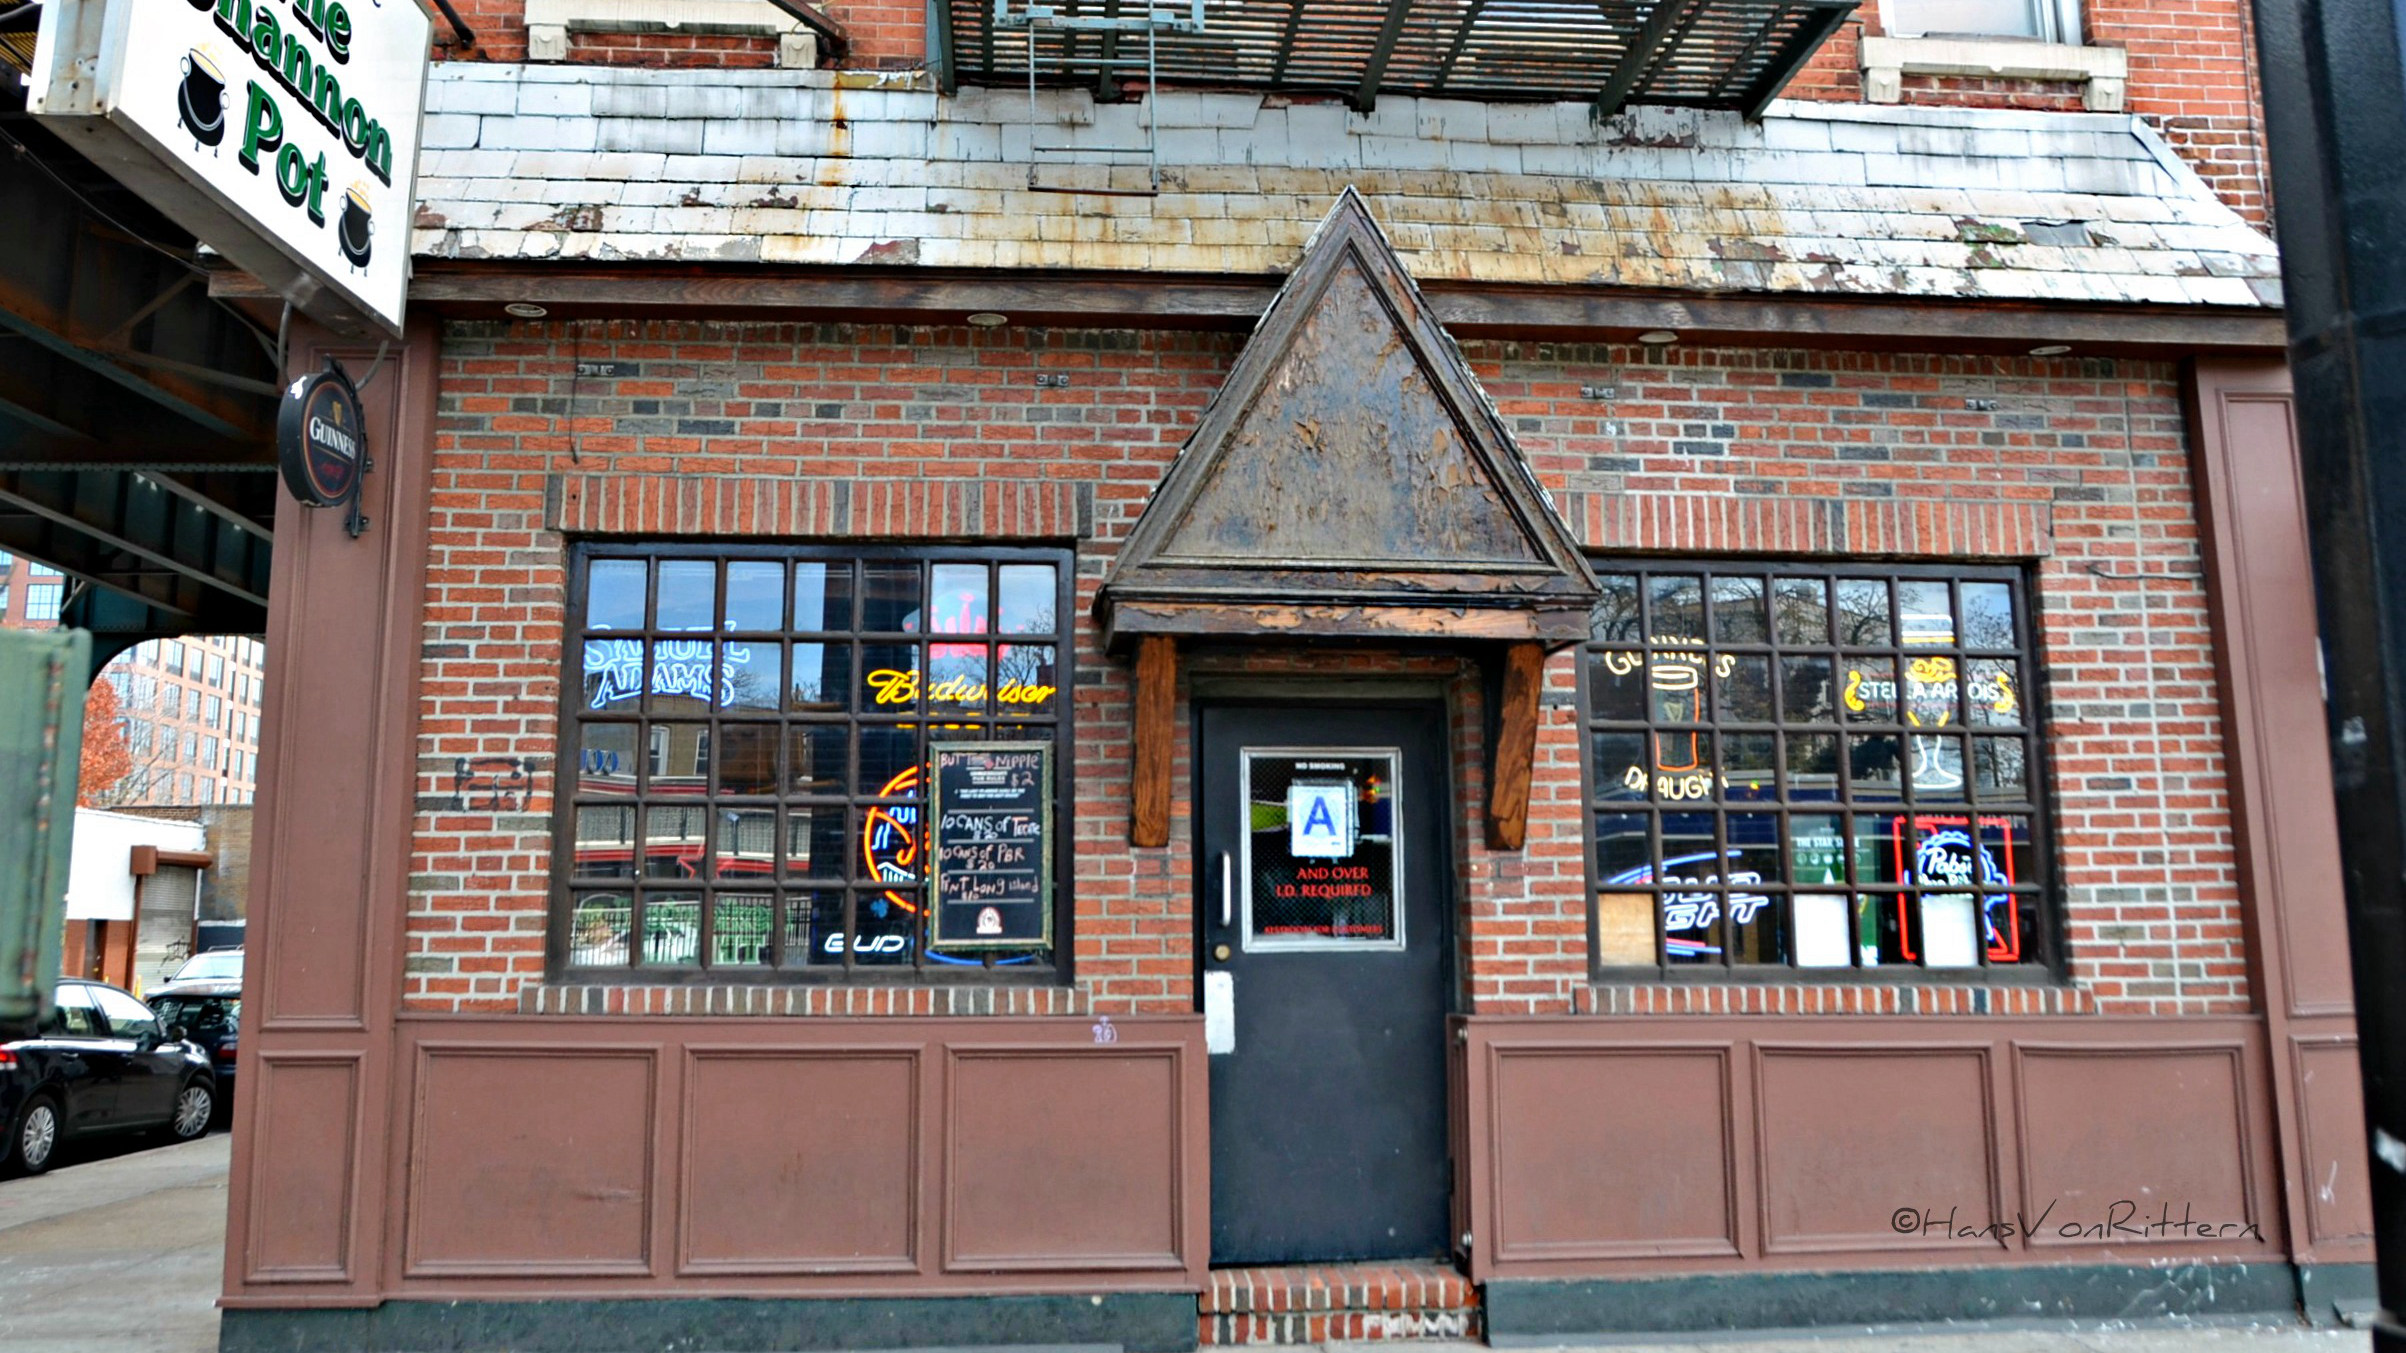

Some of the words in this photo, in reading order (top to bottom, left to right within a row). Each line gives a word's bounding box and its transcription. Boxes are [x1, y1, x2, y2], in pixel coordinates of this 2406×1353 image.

[239, 79, 329, 229] Pot
[309, 416, 357, 460] GUINNESS
[1930, 682, 2000, 702] AROIS
[1295, 762, 1308, 770] NO
[1309, 762, 1346, 771] SMOKING
[1303, 796, 1336, 836] A
[1296, 867, 1330, 880] AND
[1332, 867, 1369, 880] OVER
[1301, 884, 1373, 900] REQUIRED
